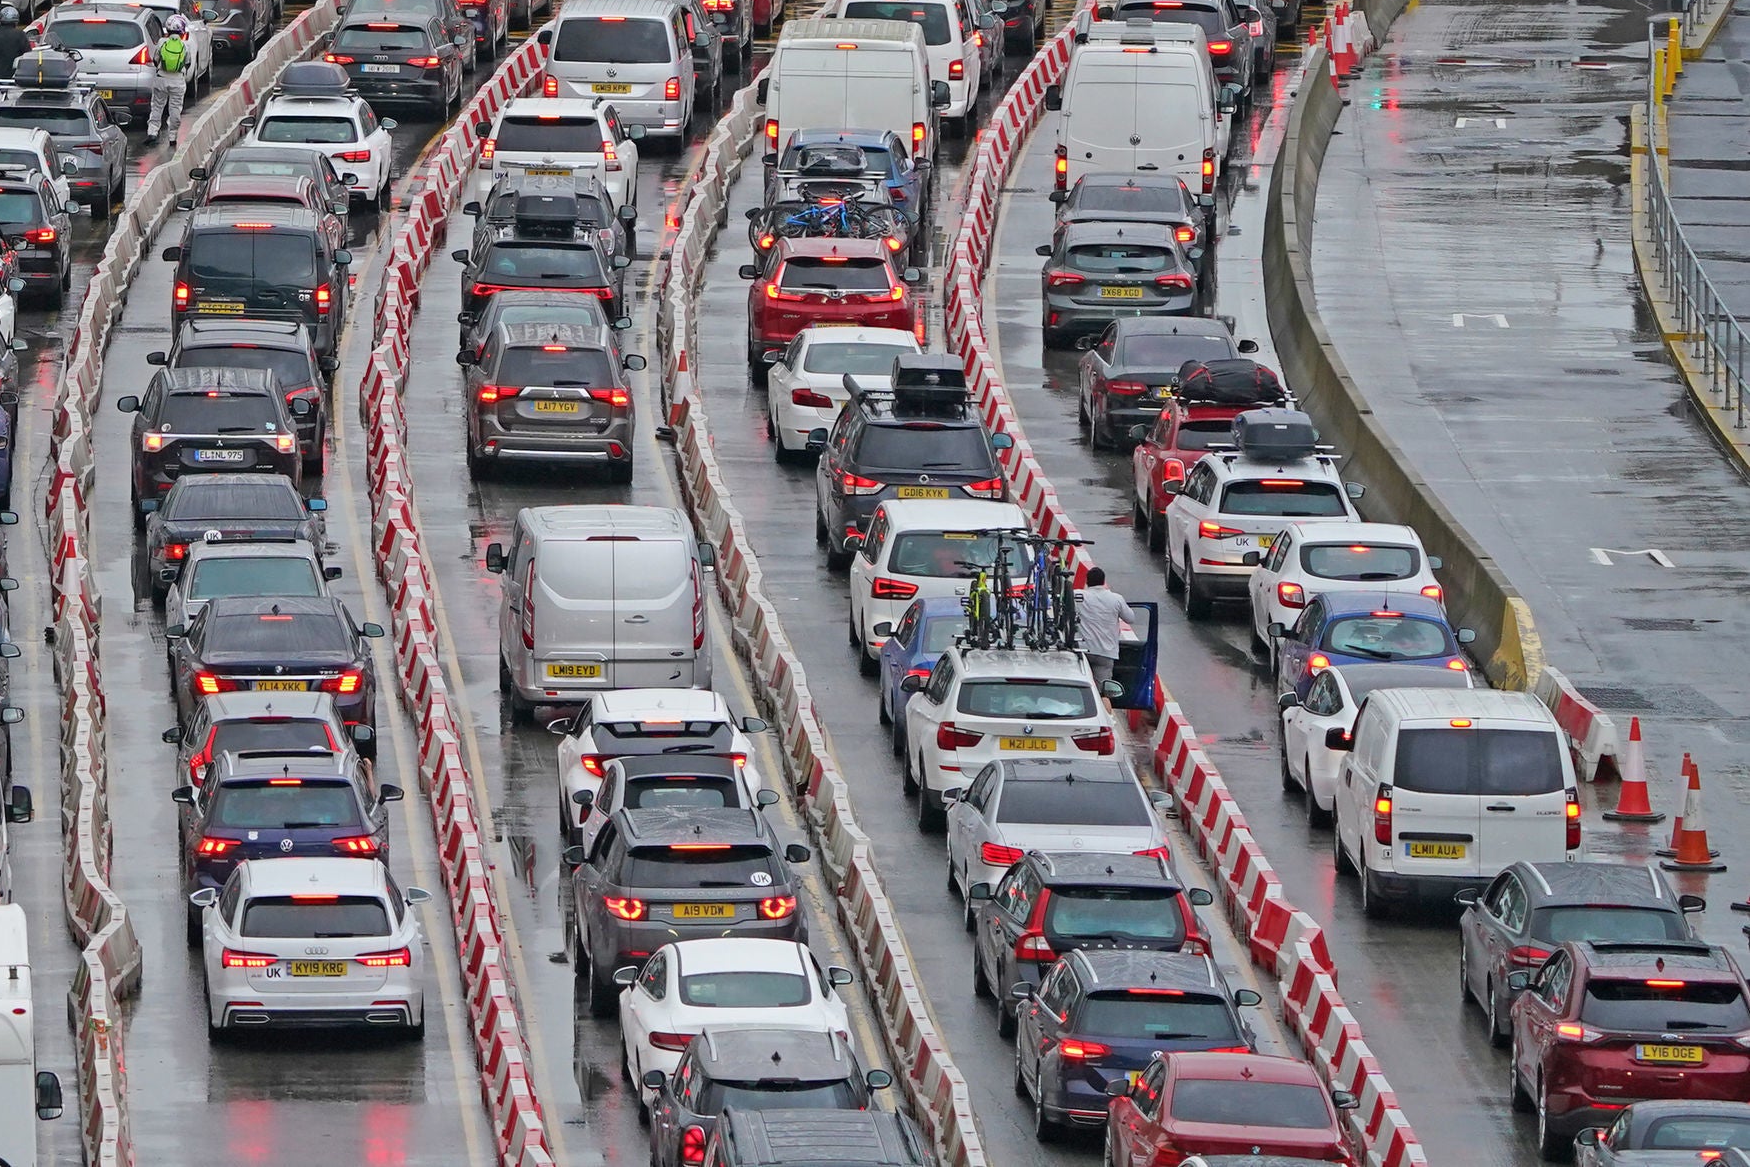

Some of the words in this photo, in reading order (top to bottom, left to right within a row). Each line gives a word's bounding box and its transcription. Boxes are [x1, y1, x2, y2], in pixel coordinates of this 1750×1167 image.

[574, 666, 595, 675] EYD
[258, 682, 279, 691] YL14
[281, 682, 300, 691] XKK
[1436, 846, 1457, 856] AUA
[753, 875, 769, 883] UK
[266, 968, 282, 979] UK
[293, 963, 319, 975] KY19
[324, 963, 346, 975] KRG
[1643, 1045, 1668, 1058] LY16
[1672, 1045, 1695, 1058] OGE
